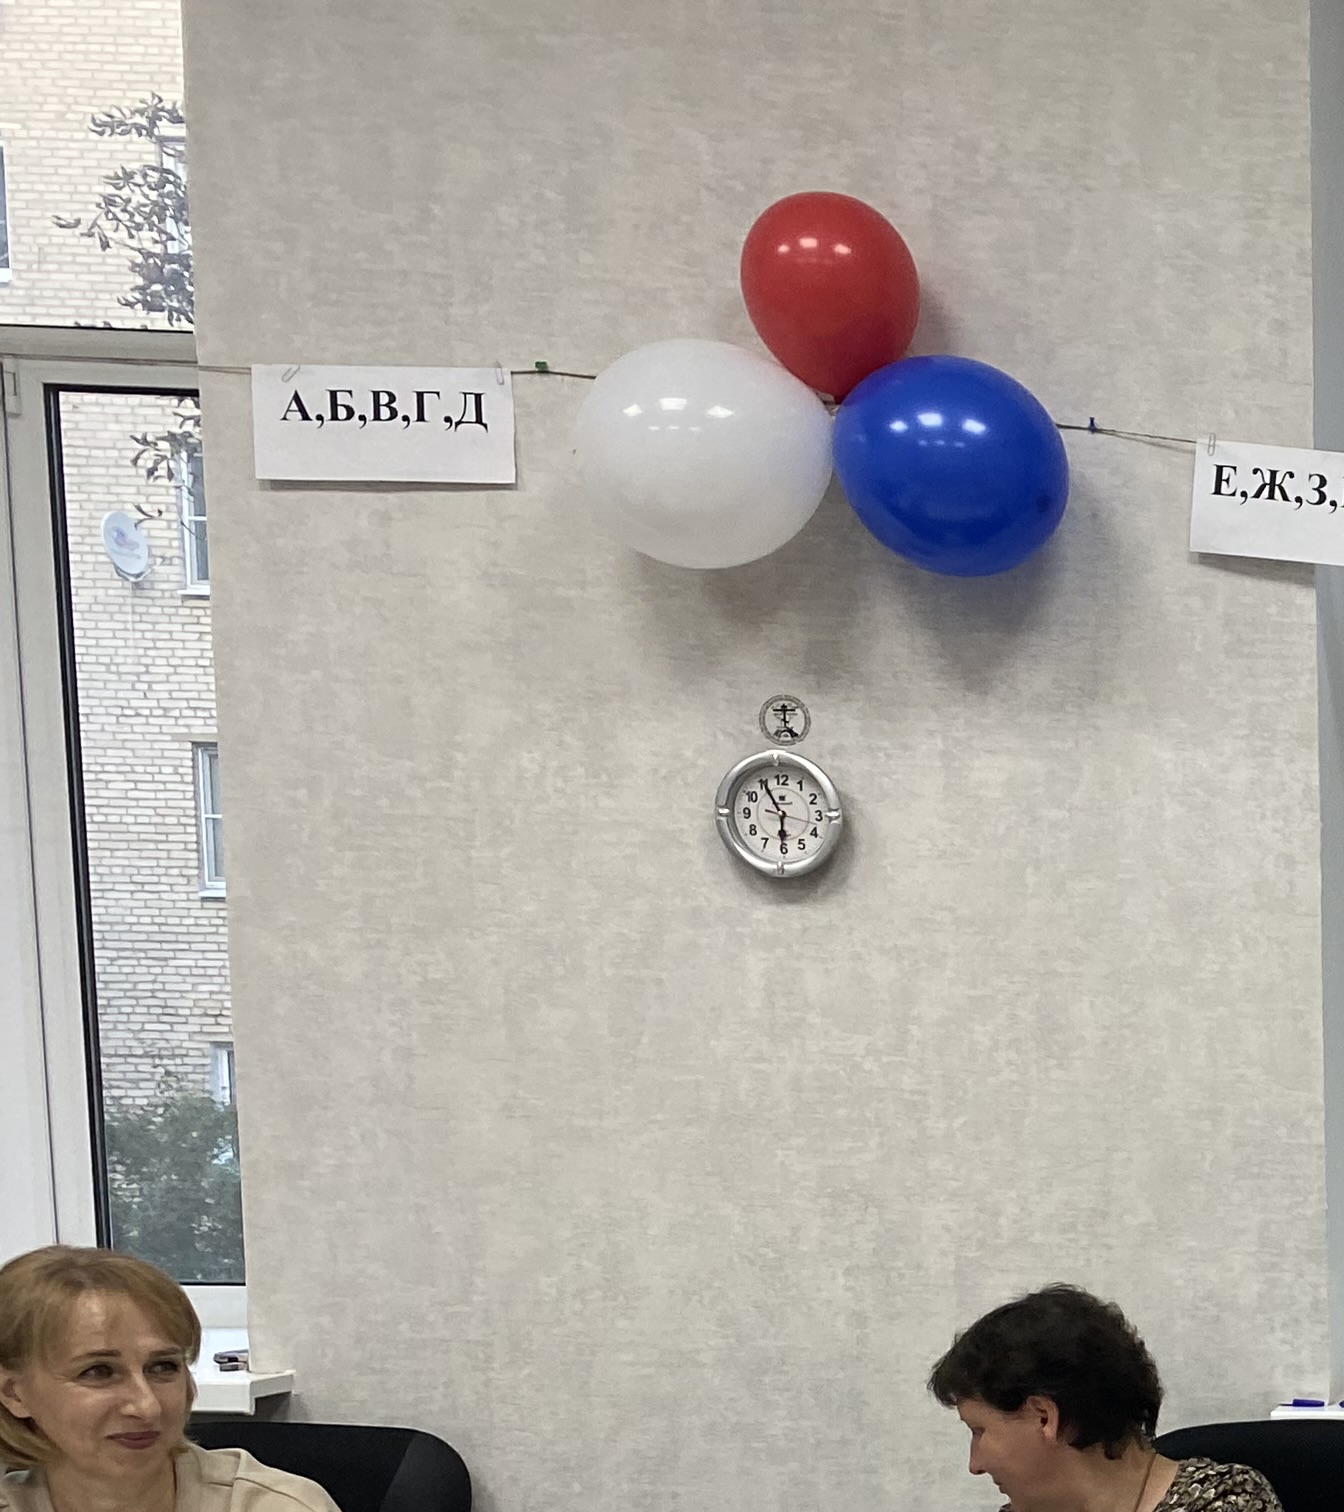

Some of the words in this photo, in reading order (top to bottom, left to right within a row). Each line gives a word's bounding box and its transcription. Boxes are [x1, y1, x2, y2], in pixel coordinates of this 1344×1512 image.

[774, 774, 789, 786] 12
[797, 780, 803, 791] 1
[746, 791, 758, 802] 10
[809, 793, 817, 805] 2
[743, 807, 751, 819] 9
[815, 810, 823, 822] 3
[749, 824, 757, 836] 8
[810, 827, 818, 838] 4
[761, 837, 769, 849] 7
[780, 843, 788, 855] 6
[798, 839, 806, 850] 5
